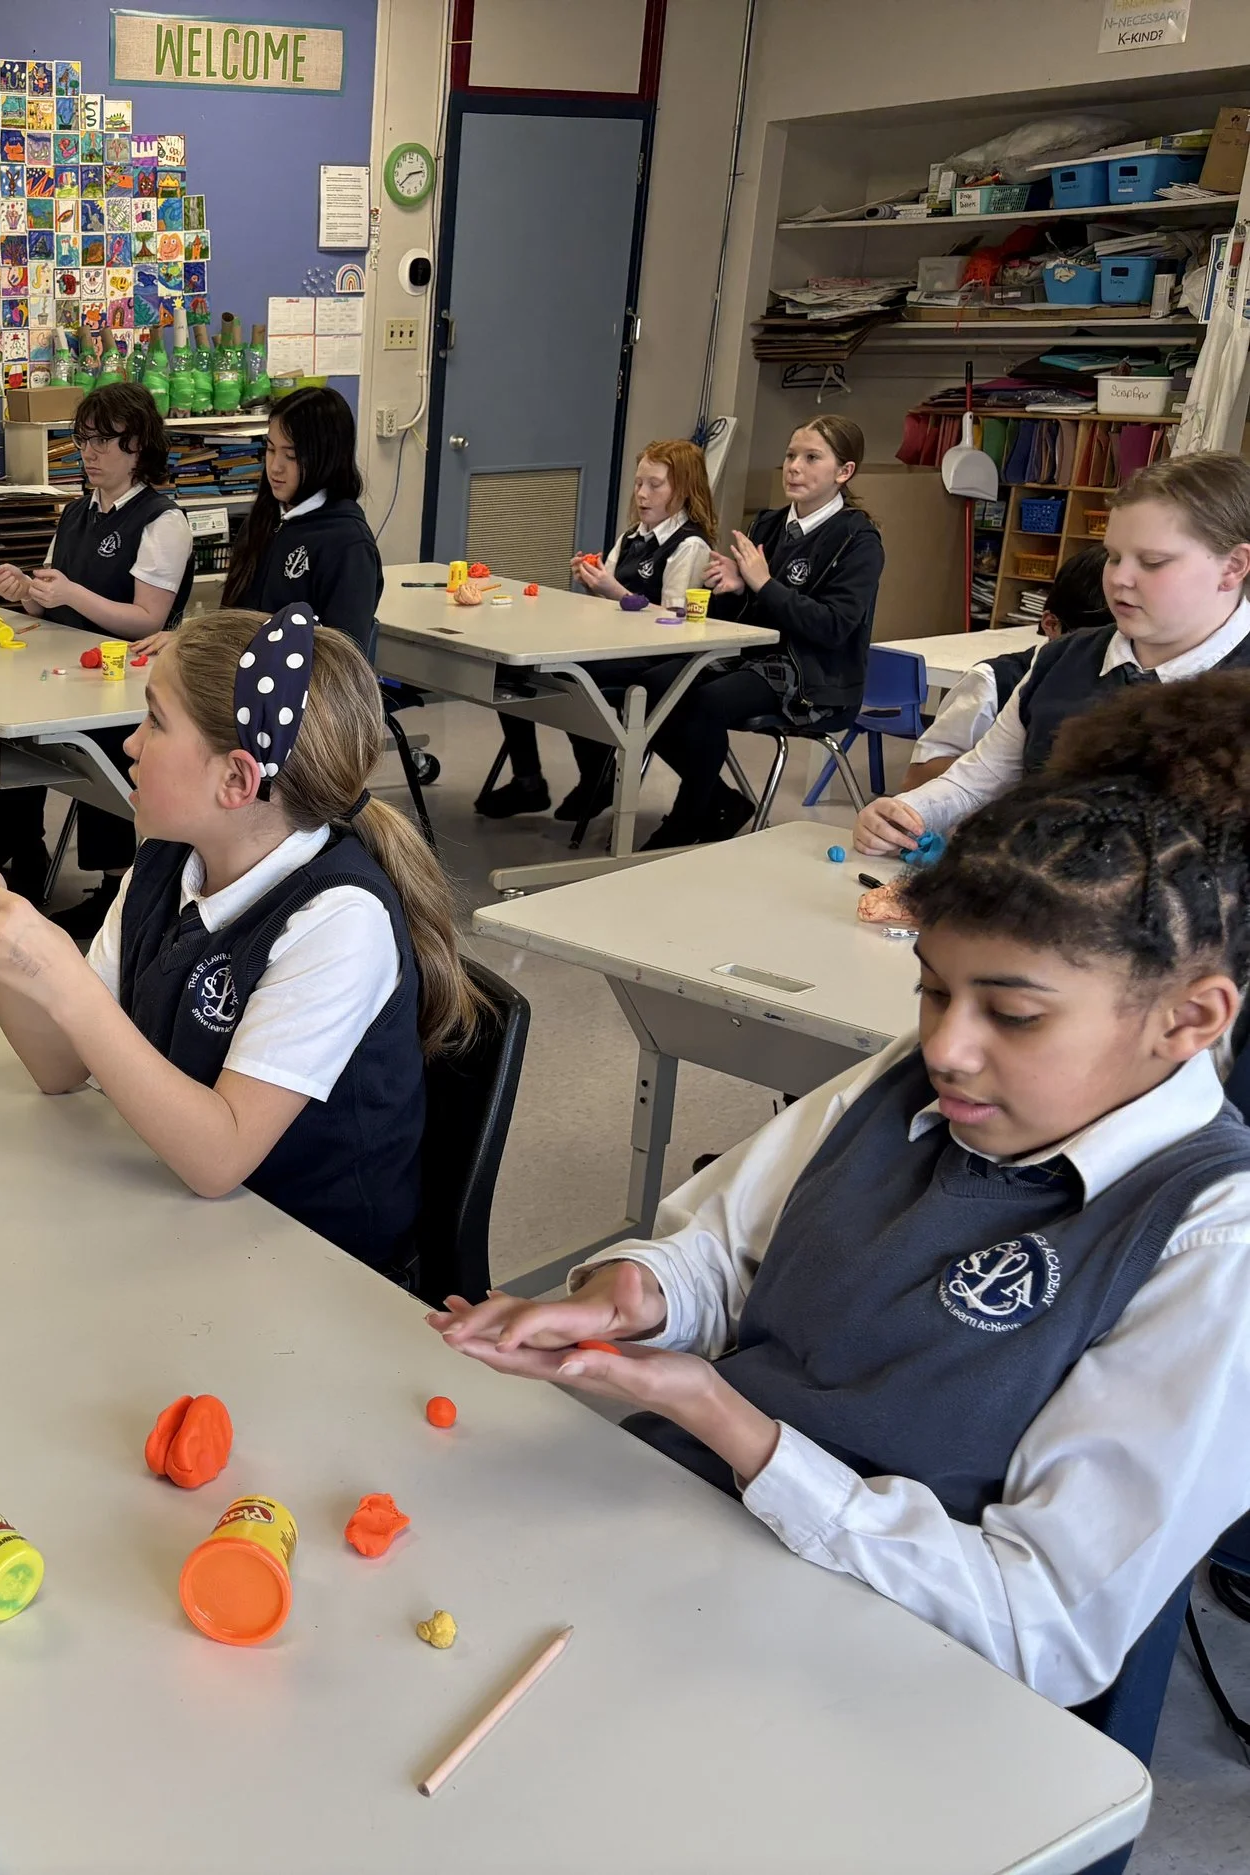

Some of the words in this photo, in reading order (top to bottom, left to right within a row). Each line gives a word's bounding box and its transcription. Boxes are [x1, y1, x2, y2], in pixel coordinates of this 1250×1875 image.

[156, 23, 306, 84] WELCOME
[1118, 30, 1163, 45] K-KIND?
[188, 972, 200, 989] THE
[205, 953, 232, 965] LAWRE
[192, 1008, 208, 1026] Strive
[208, 1023, 224, 1032] Learn
[1042, 1247, 1061, 1307] ACADEMY
[949, 1303, 978, 1327] Learn
[977, 1320, 1022, 1332] Achieve
